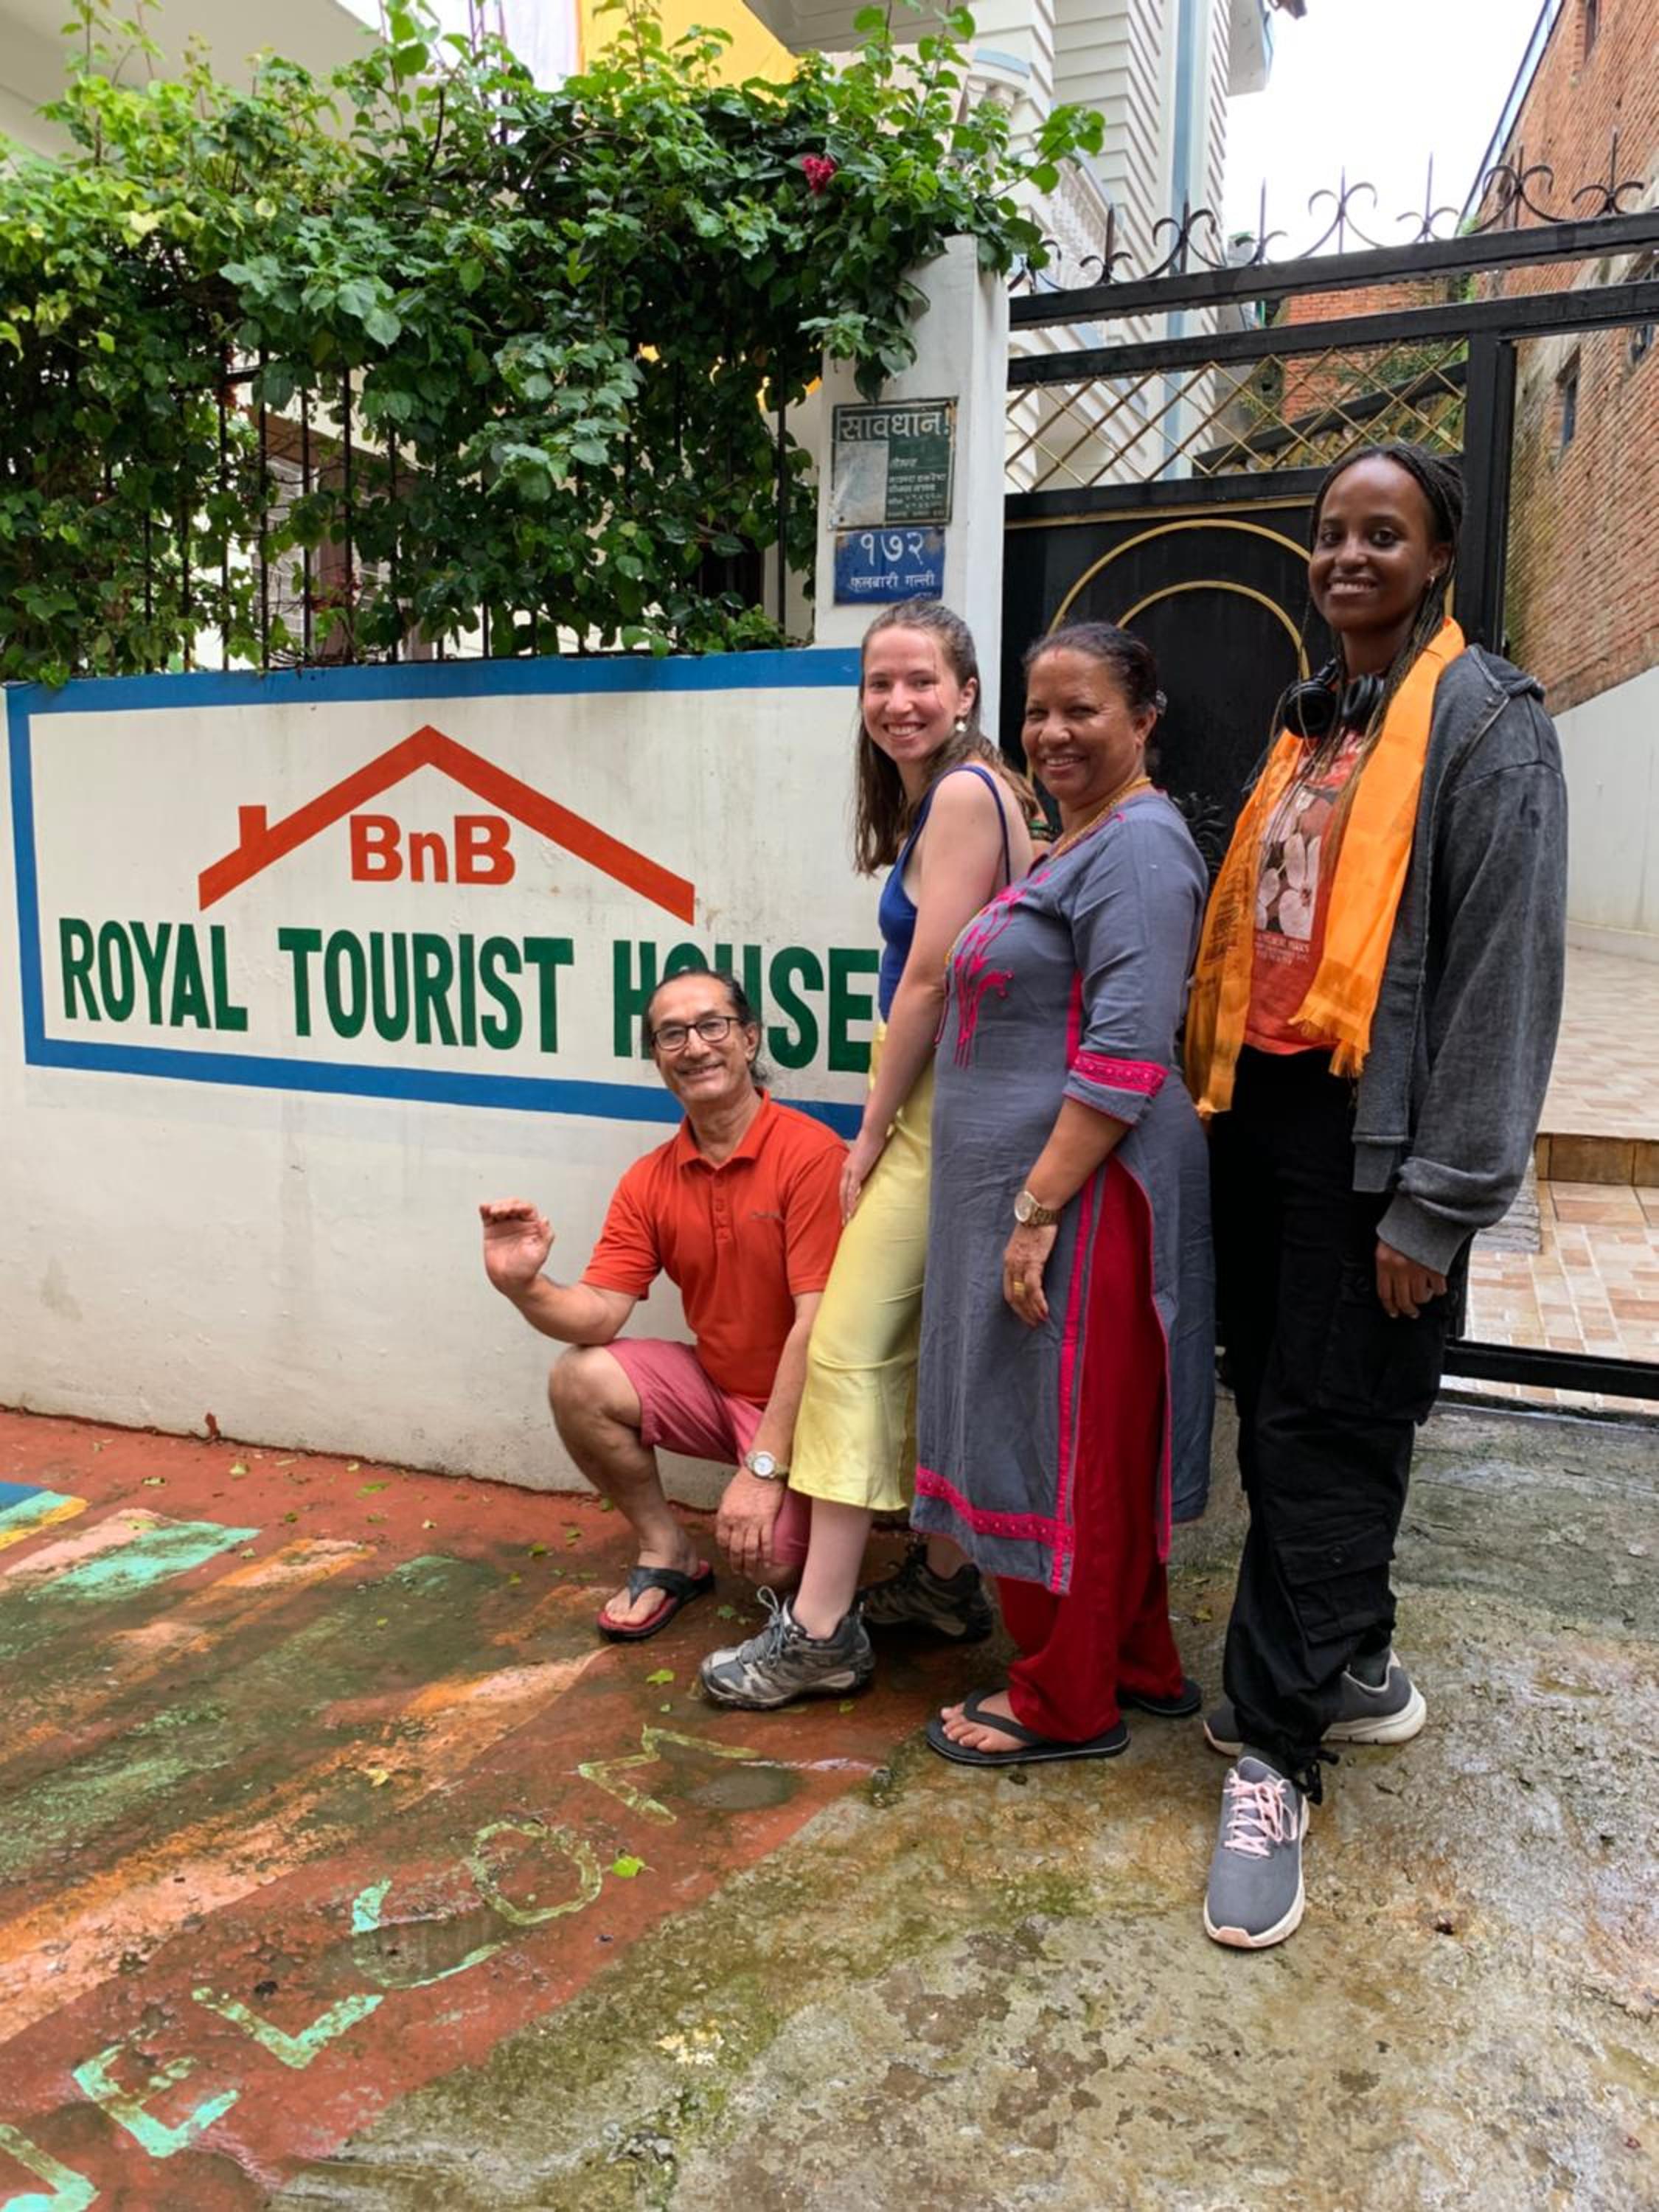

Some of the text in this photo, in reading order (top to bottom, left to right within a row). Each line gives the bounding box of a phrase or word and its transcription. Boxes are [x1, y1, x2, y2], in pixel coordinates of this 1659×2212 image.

[860, 532, 924, 566] १७२
[349, 813, 517, 885] BnB
[59, 917, 882, 1074] ROYAL TOURIST HSE
